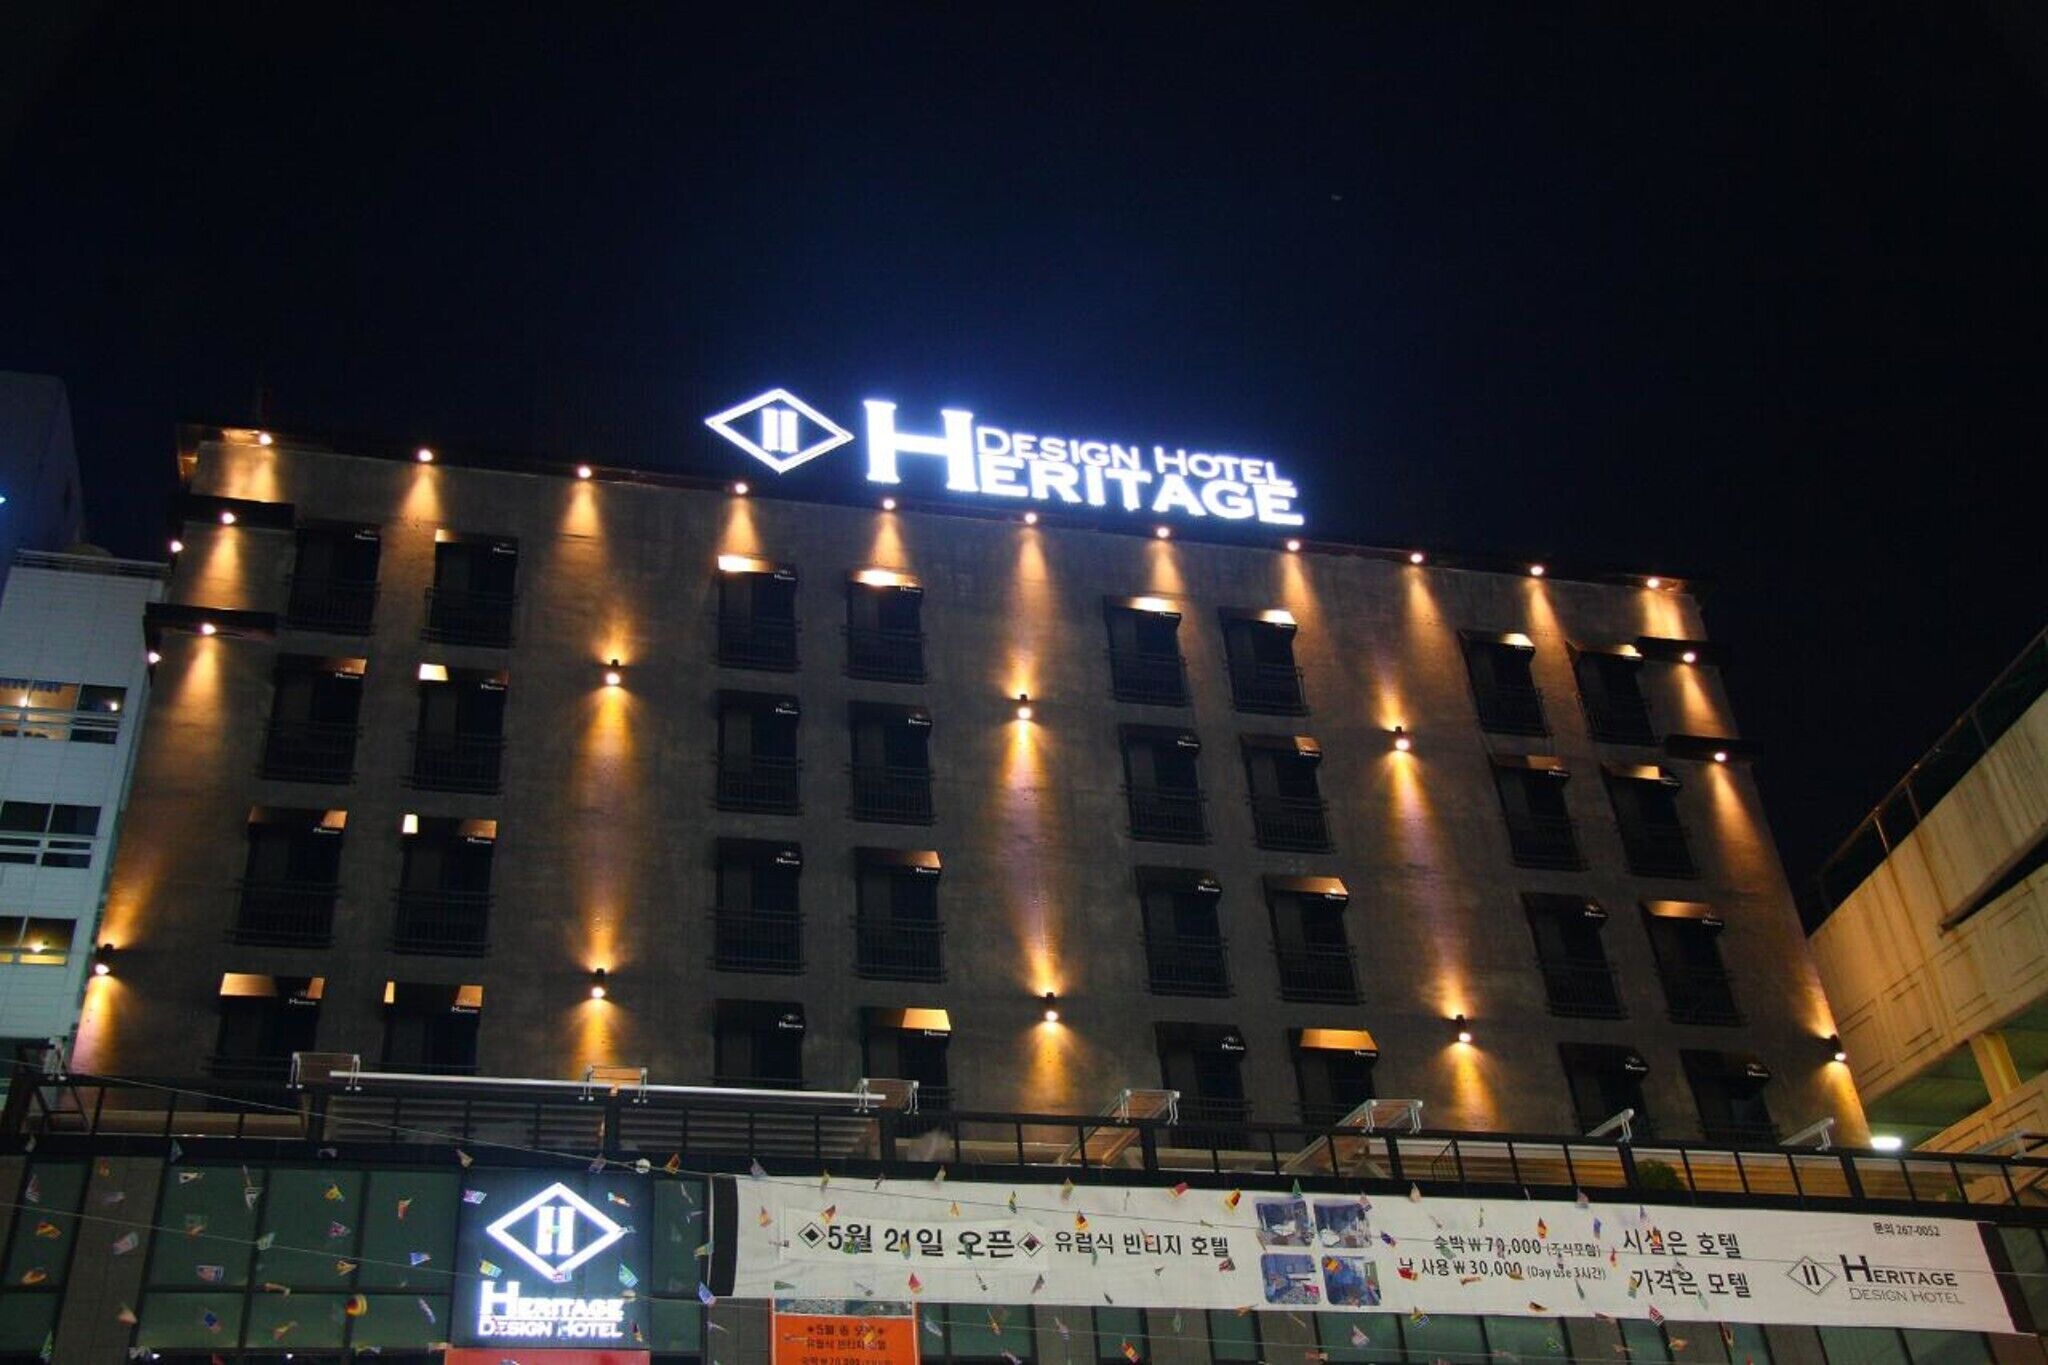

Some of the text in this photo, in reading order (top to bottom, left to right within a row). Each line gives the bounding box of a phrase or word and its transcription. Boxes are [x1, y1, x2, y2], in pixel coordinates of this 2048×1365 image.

[864, 400, 1305, 525] HERITAGE
[976, 426, 1294, 487] DESIGN HOTEL
[828, 1224, 1015, 1258] 5월 21일 오픈
[1055, 1231, 1229, 1257] 유럽식 빈티지 호텔
[1624, 1229, 1742, 1259] 시설은 호텔
[1422, 1258, 1449, 1276] 사용
[1839, 1254, 1958, 1287] HERITAGE
[1632, 1269, 1752, 1298] 가격은 모텔
[1850, 1287, 1965, 1305] DESIGN HOTEL
[480, 1281, 624, 1321] HERITAGE
[478, 1316, 624, 1339] DESIGN HOTEL
